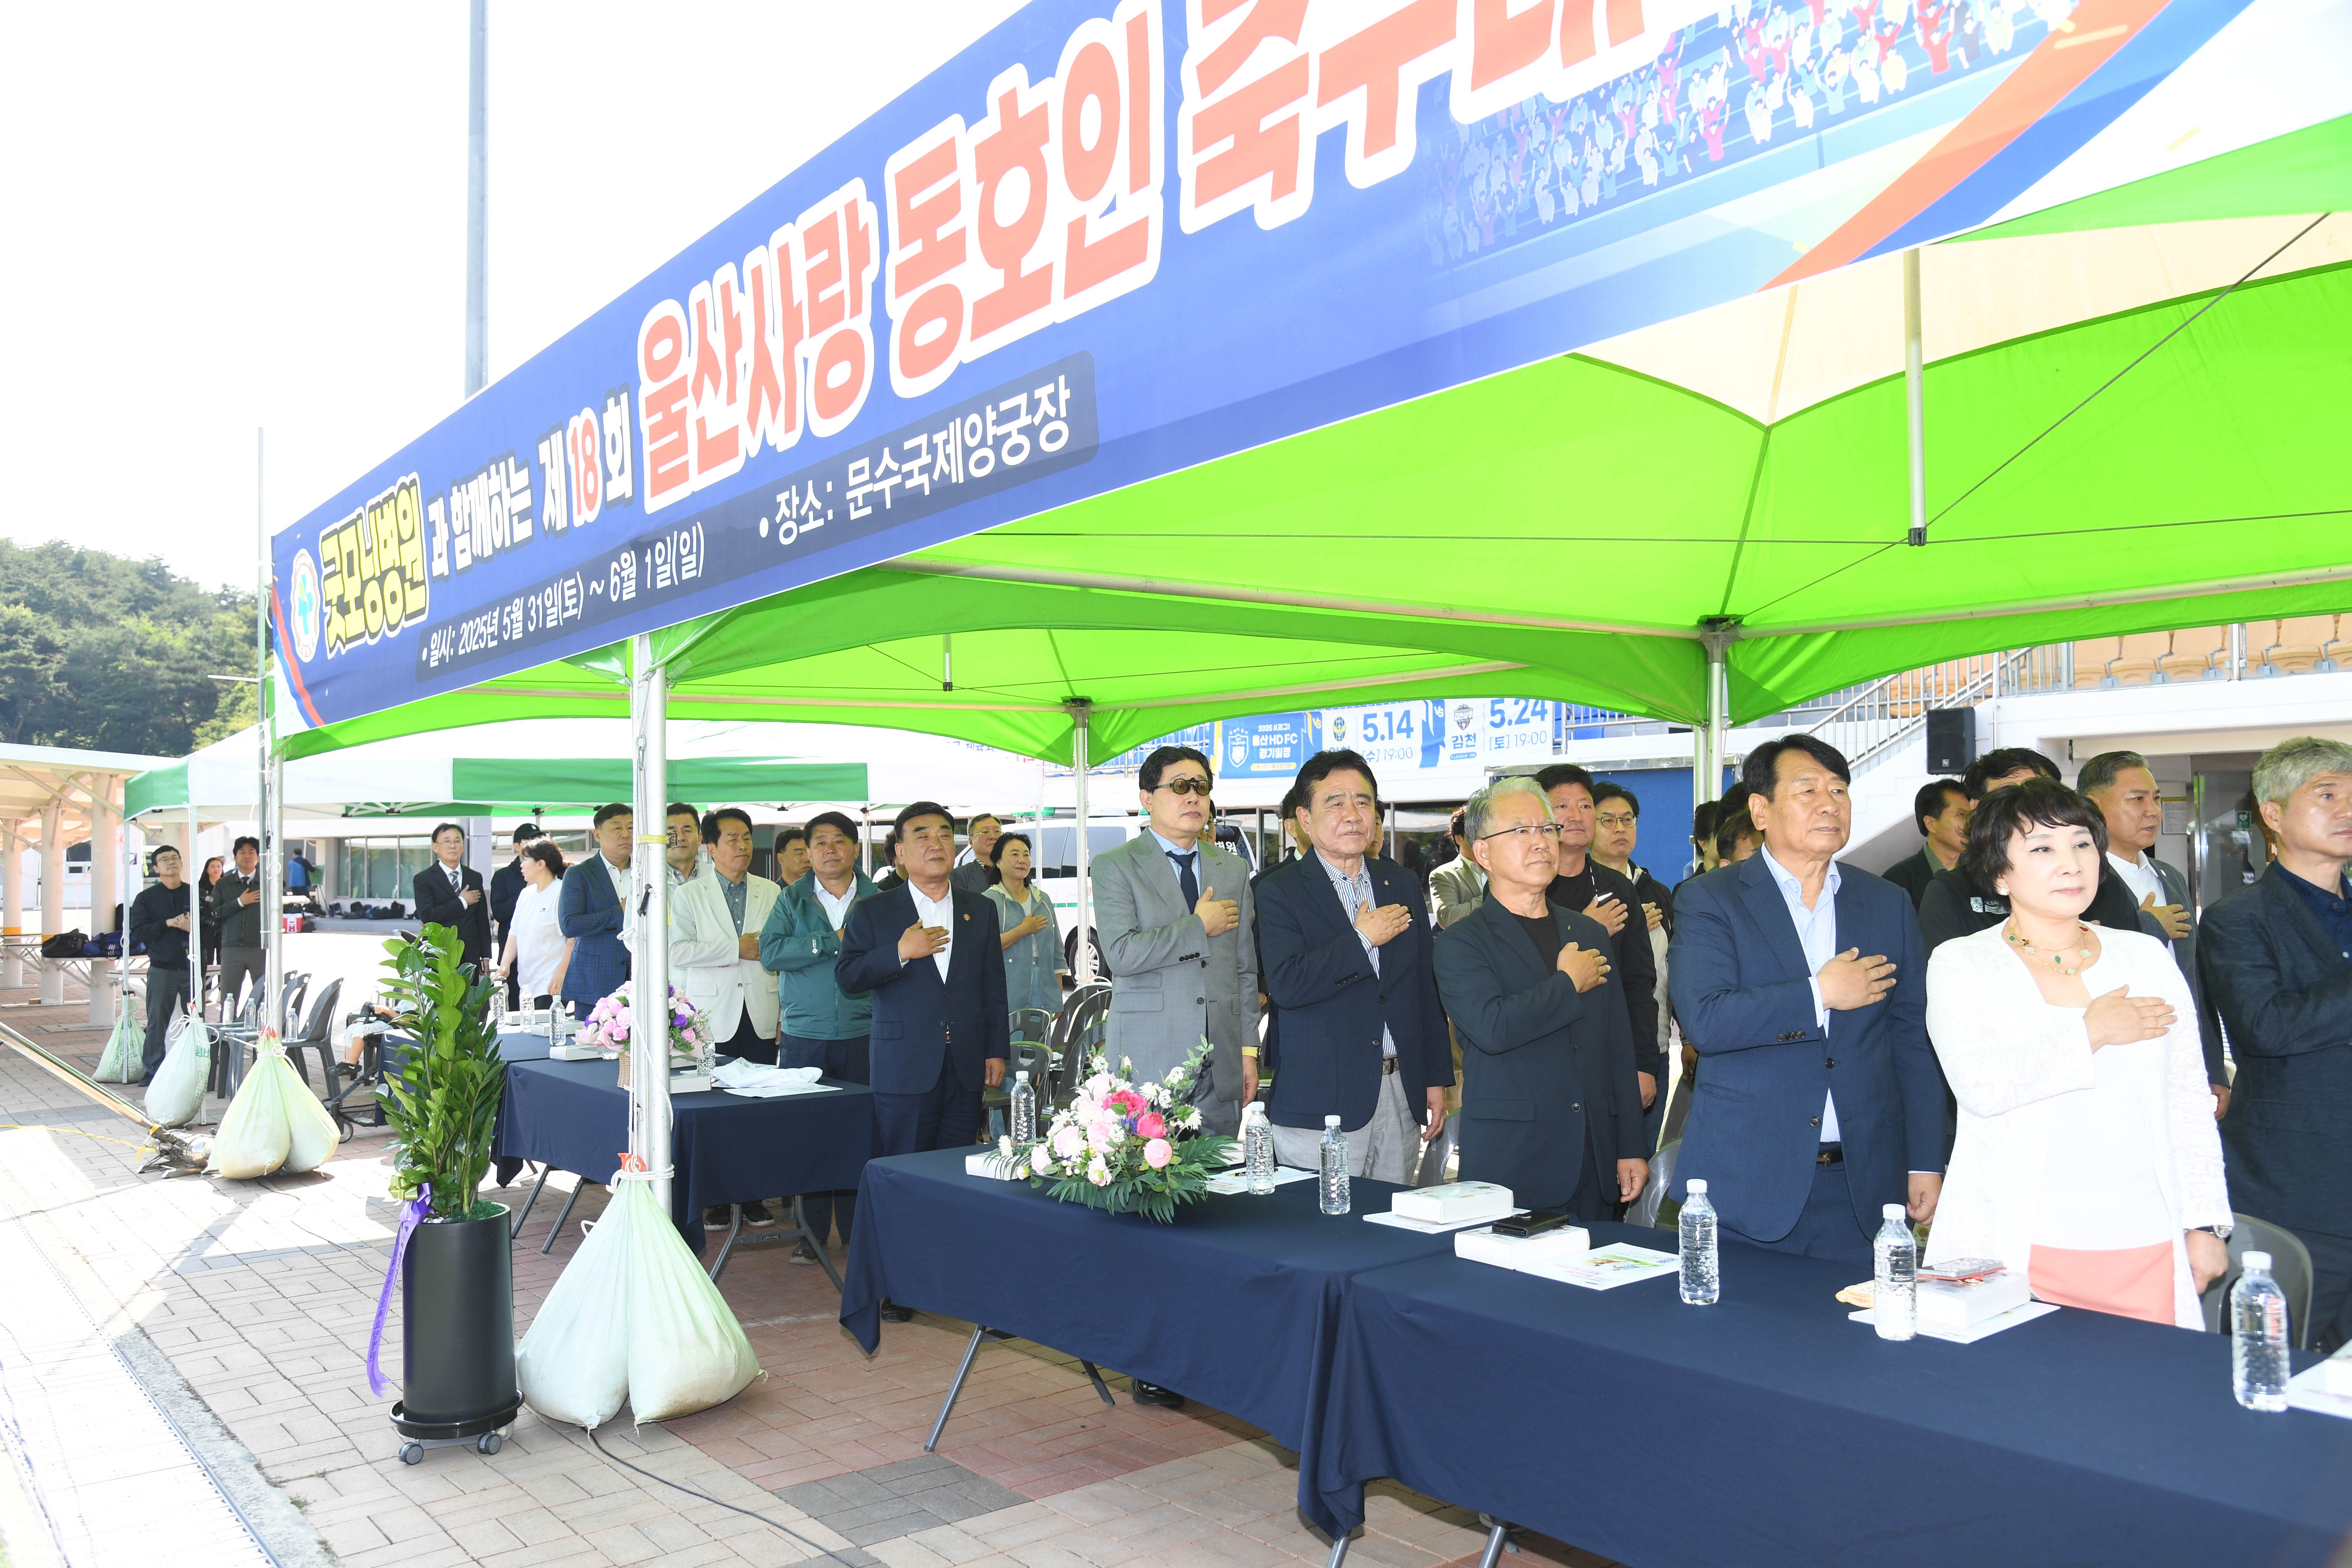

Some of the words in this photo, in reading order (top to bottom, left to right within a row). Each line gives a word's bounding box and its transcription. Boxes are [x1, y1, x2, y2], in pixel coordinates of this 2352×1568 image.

[322, 486, 426, 648] 굿모닝병원
[450, 457, 532, 570] 함께하는
[644, 197, 871, 498] 울산사랑
[894, 8, 1151, 379] 동호인
[776, 480, 833, 545] 장소:
[846, 374, 1070, 520] 문수국제양궁장
[430, 626, 455, 667] 일시:
[458, 607, 498, 656] 2025년
[503, 596, 524, 640] 5월
[528, 571, 584, 632] 31일(토)
[610, 550, 636, 602] 6월
[645, 522, 704, 590] 1일(일)
[1434, 706, 1444, 717] VS
[1490, 698, 1548, 728] 5.24
[1258, 724, 1272, 732] 2025
[1363, 710, 1414, 742] 5.14
[1269, 734, 1283, 745] HD
[1284, 733, 1298, 745] FC
[1451, 733, 1476, 749] 김천
[1489, 735, 1510, 750] [토]
[1514, 731, 1547, 747] 19:00
[1259, 747, 1291, 759] 경기일정
[1384, 747, 1413, 761] 19:00
